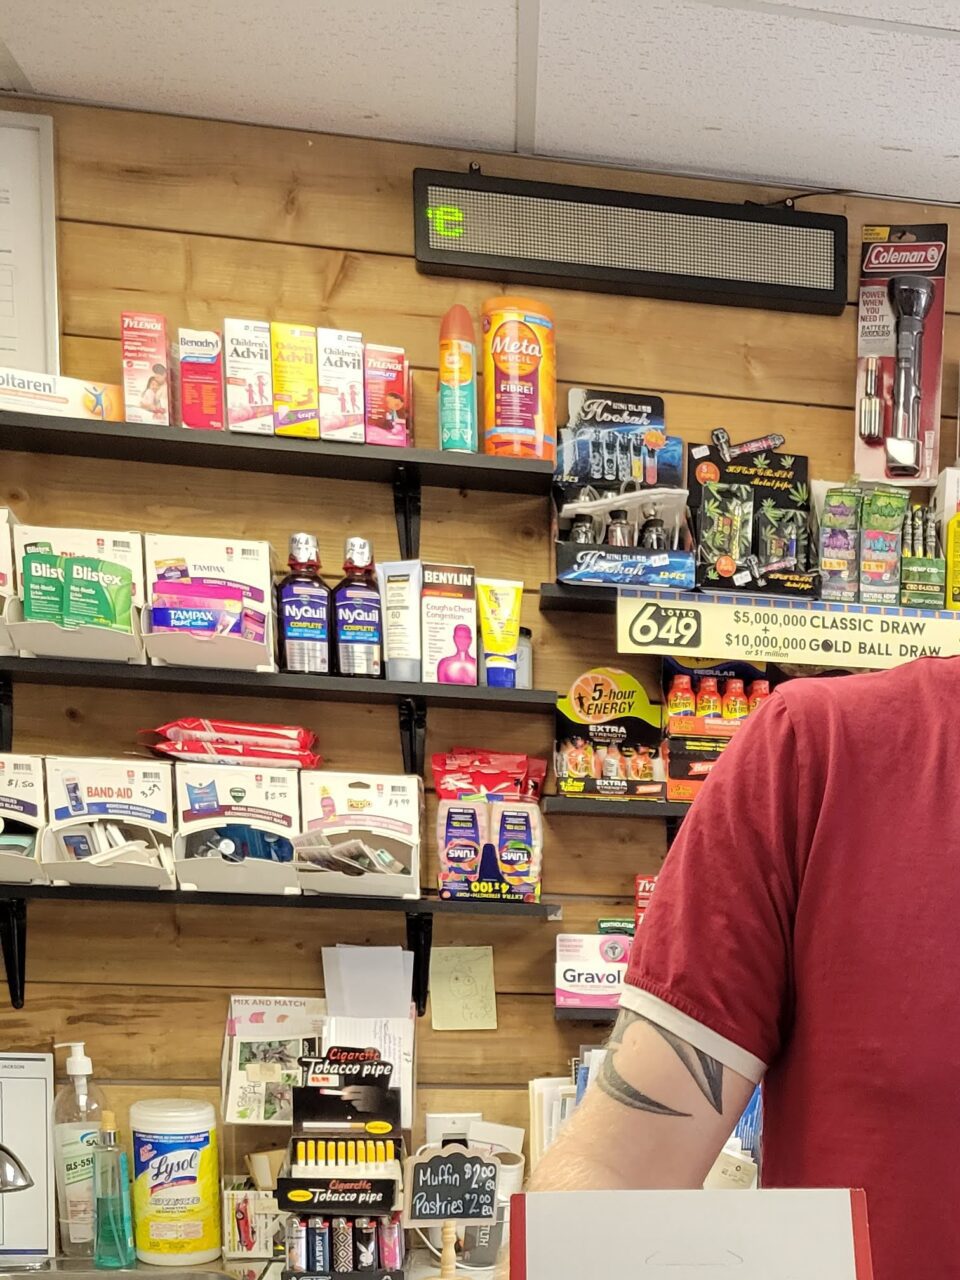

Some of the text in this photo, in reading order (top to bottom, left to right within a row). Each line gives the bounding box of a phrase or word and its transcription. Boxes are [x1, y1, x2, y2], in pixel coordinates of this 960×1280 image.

[871, 246, 926, 265] Coleman
[123, 317, 162, 331] TYLENOL
[229, 347, 268, 360] Advil
[492, 337, 542, 357] Meta
[323, 357, 361, 370] Advil
[367, 358, 402, 371] TYLENOL
[500, 384, 533, 394] FIBRE!
[581, 399, 651, 425] Hookah
[192, 564, 225, 573] TAMPAX
[72, 565, 122, 587] Blistex
[424, 571, 472, 586] BENYLIN
[285, 605, 326, 620] NyQuil
[426, 603, 448, 613] Cough
[453, 605, 472, 613] Chest
[661, 609, 695, 617] LOTTO
[168, 610, 213, 621] TAMPAX
[338, 608, 379, 623] NyQuil
[426, 611, 464, 620] Congestion
[733, 611, 926, 635] $5,000,000 CLASSIC DRAW
[725, 633, 941, 658] $10,000,000 GOLD BALL DRAW
[764, 650, 788, 658] million
[694, 669, 735, 677] REGULAR
[592, 684, 637, 701] 5-hour
[587, 701, 635, 715] ENERGY
[589, 725, 627, 733] EXTRA
[448, 849, 475, 858] TUMS
[501, 852, 528, 861] TUMS
[471, 882, 493, 892] 100
[563, 968, 621, 984] Gravol
[233, 998, 250, 1006] MIX
[274, 999, 306, 1008] MATCH
[329, 1048, 380, 1063] Cigarette
[302, 1057, 392, 1079] Tobacco pipe
[150, 1151, 197, 1182] Lysol
[419, 1163, 460, 1187] Muffin
[329, 1180, 371, 1191] Cigarette
[308, 1188, 383, 1204] Tobacco pipe
[413, 1192, 463, 1216] Pastries
[316, 1235, 324, 1272] PLAYBOY
